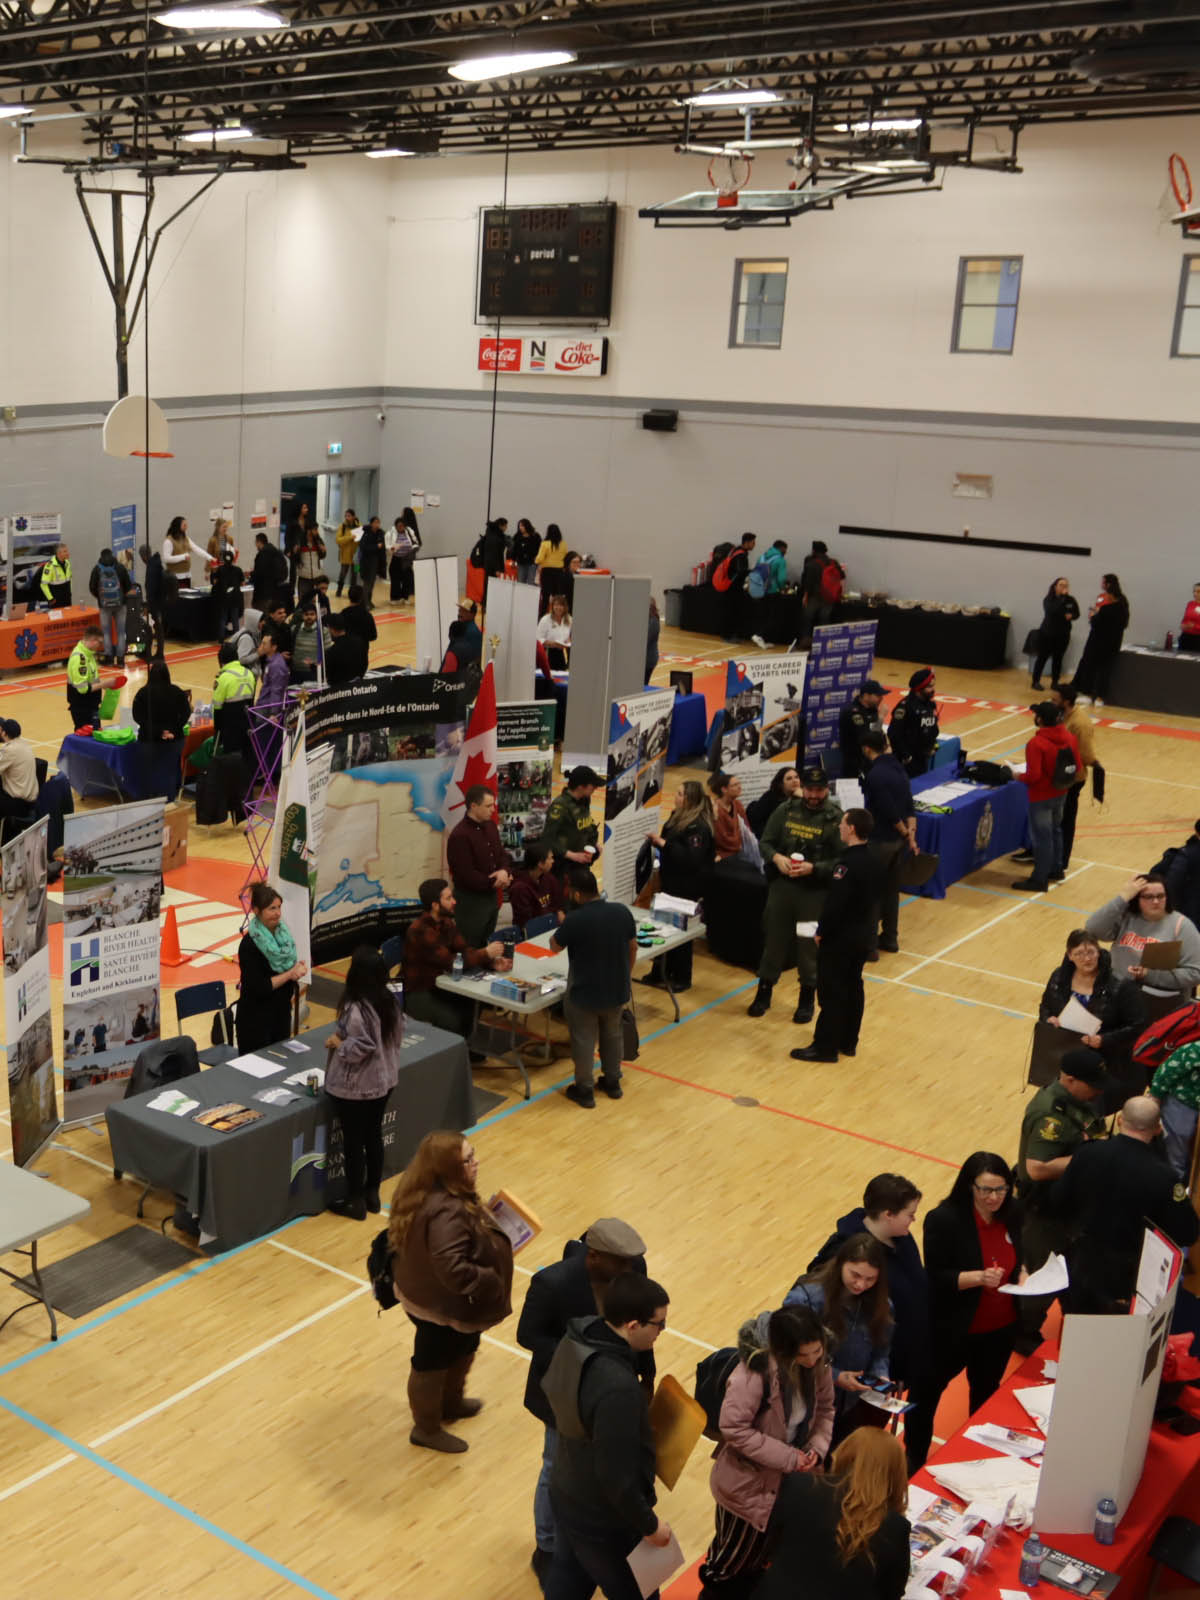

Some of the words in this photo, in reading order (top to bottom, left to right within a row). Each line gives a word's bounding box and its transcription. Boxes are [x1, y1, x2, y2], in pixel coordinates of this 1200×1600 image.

[575, 341, 592, 352] diet
[561, 347, 597, 365] Coke
[751, 663, 771, 671] YOUR
[772, 661, 802, 670] CAREER
[752, 670, 780, 679] STARTS
[781, 668, 800, 676] HERE
[353, 684, 378, 696] Ontario
[397, 703, 406, 713] de
[407, 702, 440, 712] l'Ontario
[104, 929, 140, 943] BLANCHE
[104, 942, 126, 954] RIVER
[128, 935, 158, 948] HEALTH
[104, 956, 128, 969] SANTÉ
[104, 964, 140, 978] BLANCHE
[71, 985, 101, 999] Englehart
[102, 982, 114, 991] and
[115, 976, 143, 987] Kirkland
